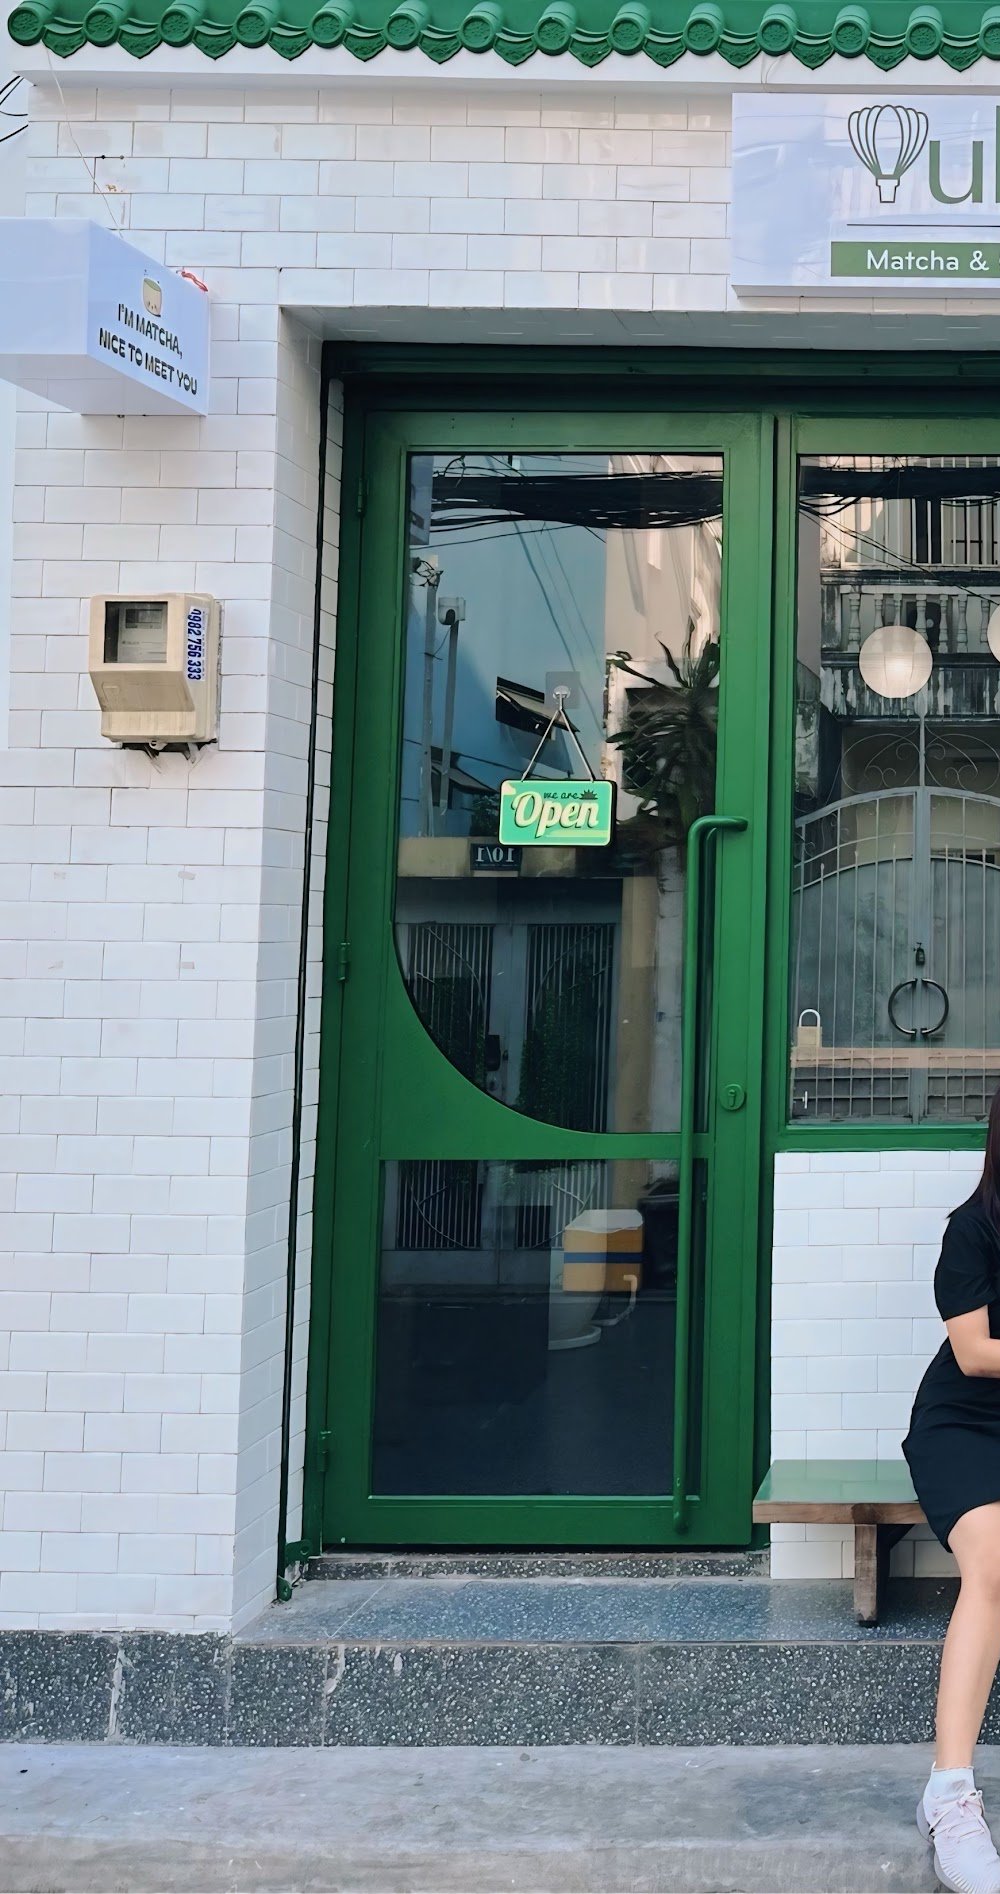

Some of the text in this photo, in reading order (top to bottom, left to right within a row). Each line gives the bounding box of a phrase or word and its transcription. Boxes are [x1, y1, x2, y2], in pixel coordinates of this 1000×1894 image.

[866, 249, 960, 271] Matcha
[968, 251, 990, 272] &
[118, 303, 183, 359] I'M MATCHA,
[99, 328, 198, 395] NICE TO MEET YOU
[511, 791, 599, 838] Open
[560, 792, 580, 800] are
